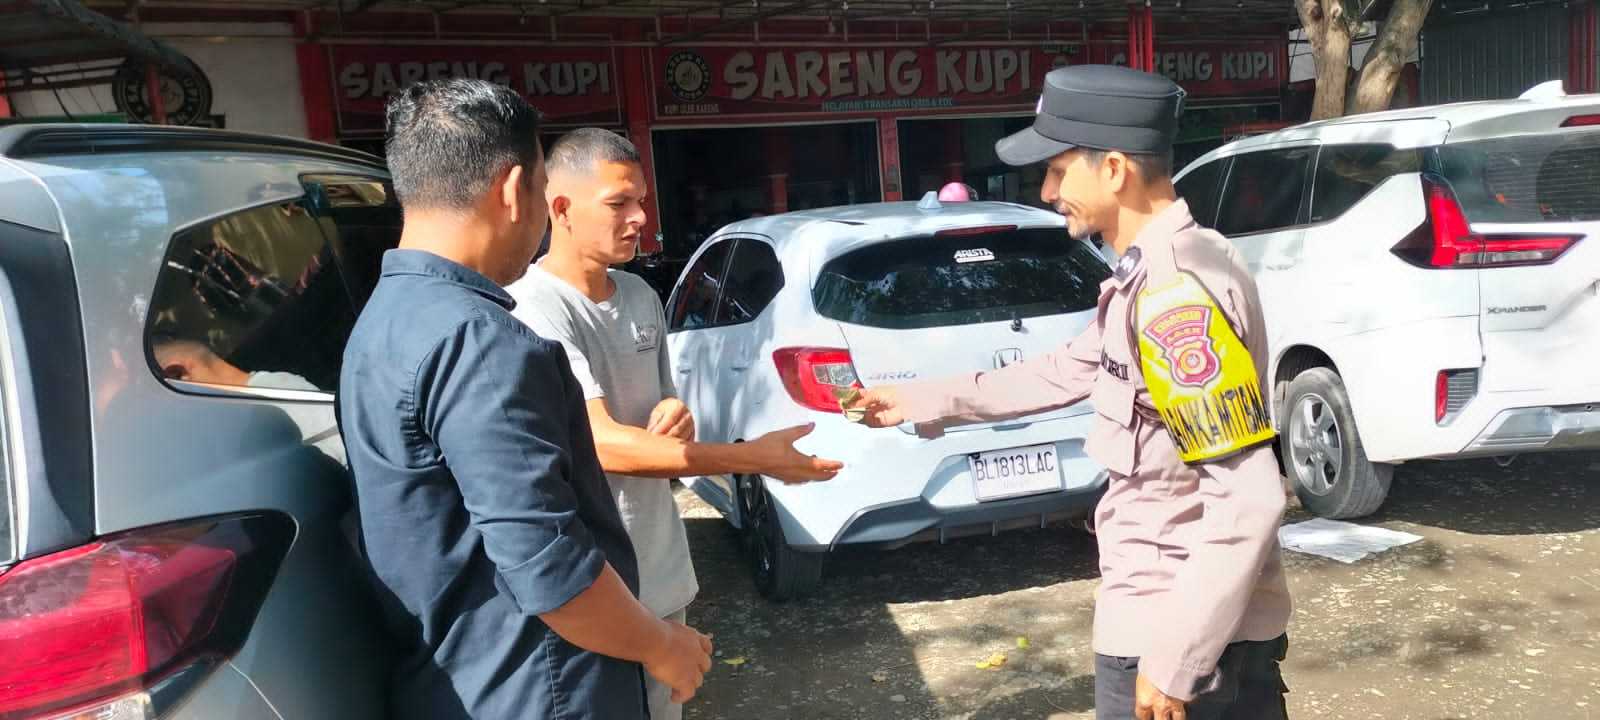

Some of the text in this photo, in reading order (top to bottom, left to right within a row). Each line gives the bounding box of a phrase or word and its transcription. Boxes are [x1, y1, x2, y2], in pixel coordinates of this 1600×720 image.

[522, 60, 610, 96] KUPI
[724, 49, 1031, 99] SARENG KUPI
[1221, 52, 1275, 80] KUPI
[953, 248, 993, 259] ARISTA
[1487, 304, 1547, 315] XPANDER
[975, 451, 1054, 481] BL1813LAC
